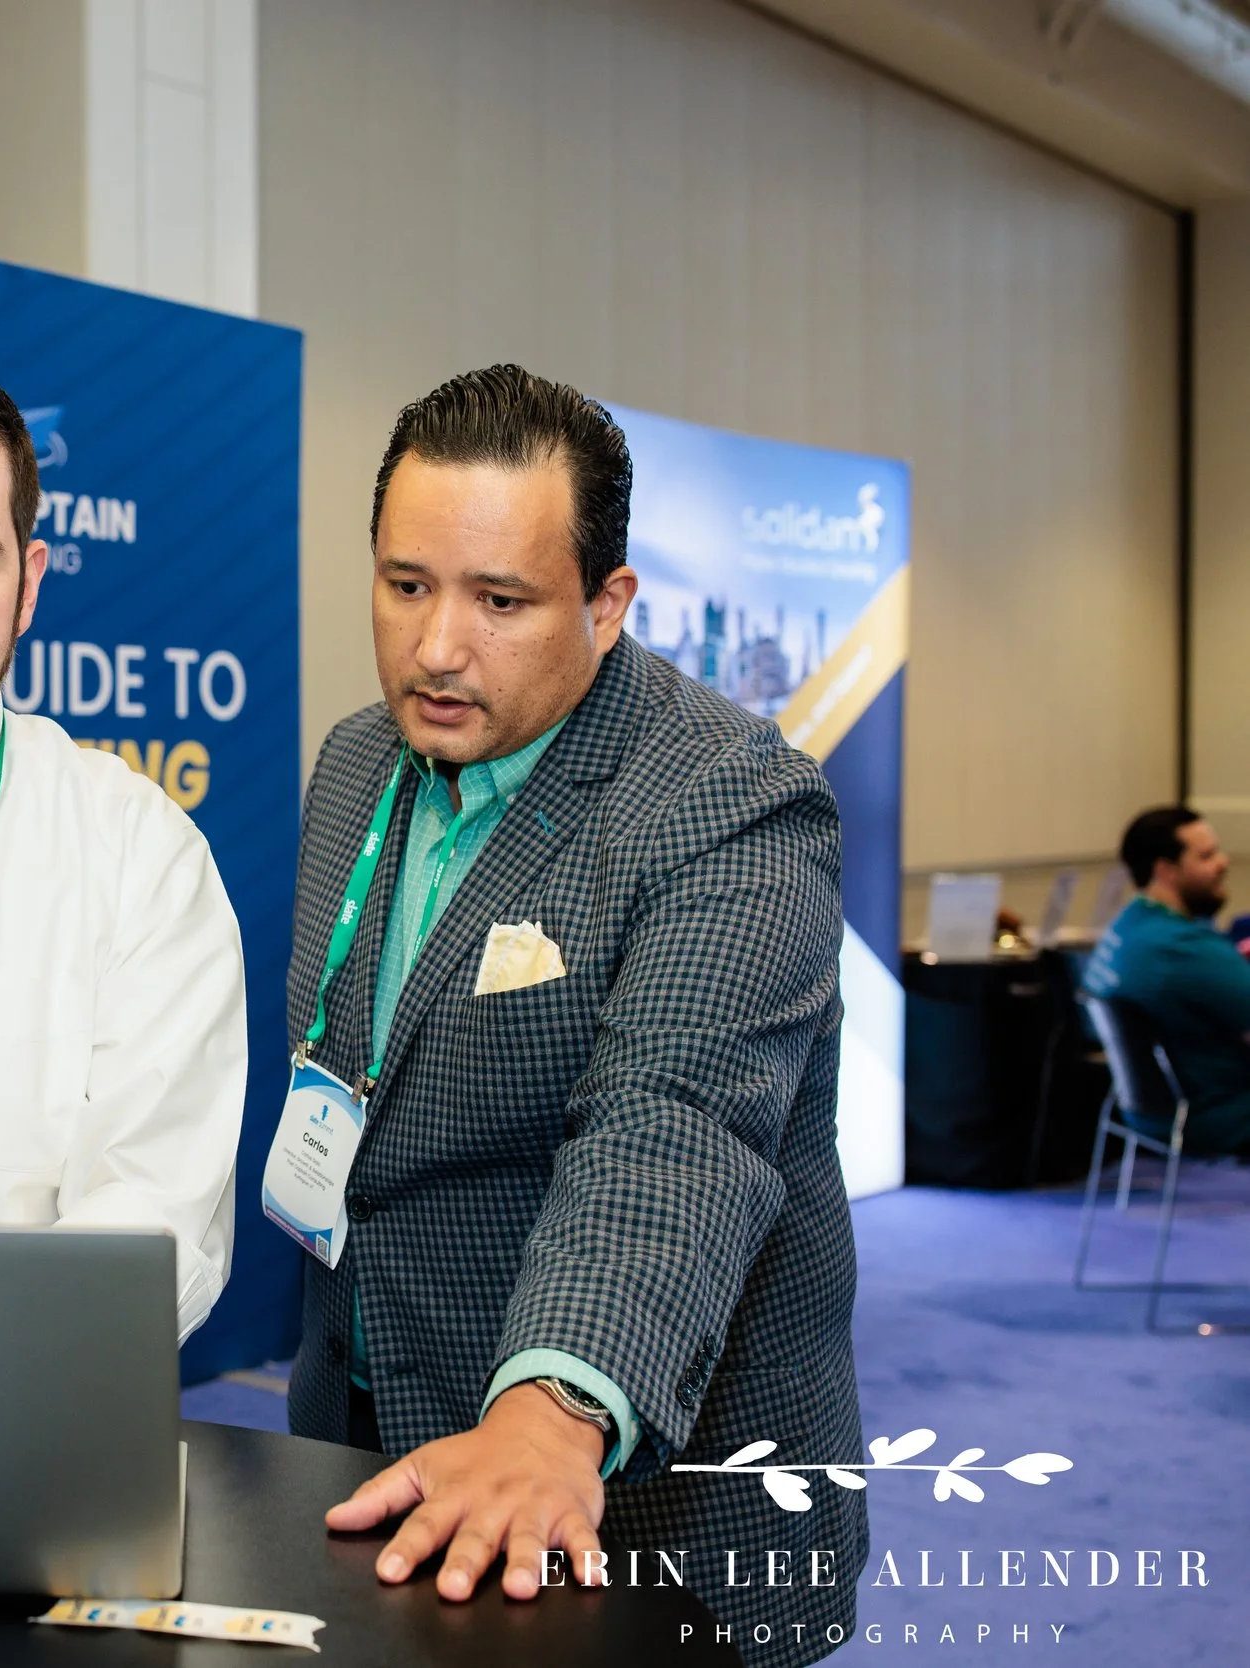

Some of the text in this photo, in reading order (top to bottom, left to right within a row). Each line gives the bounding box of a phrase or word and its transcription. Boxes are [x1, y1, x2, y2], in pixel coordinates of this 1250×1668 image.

[164, 647, 247, 722] TO
[363, 831, 380, 857] slate
[341, 899, 358, 925] slate
[303, 1132, 329, 1156] Carlos
